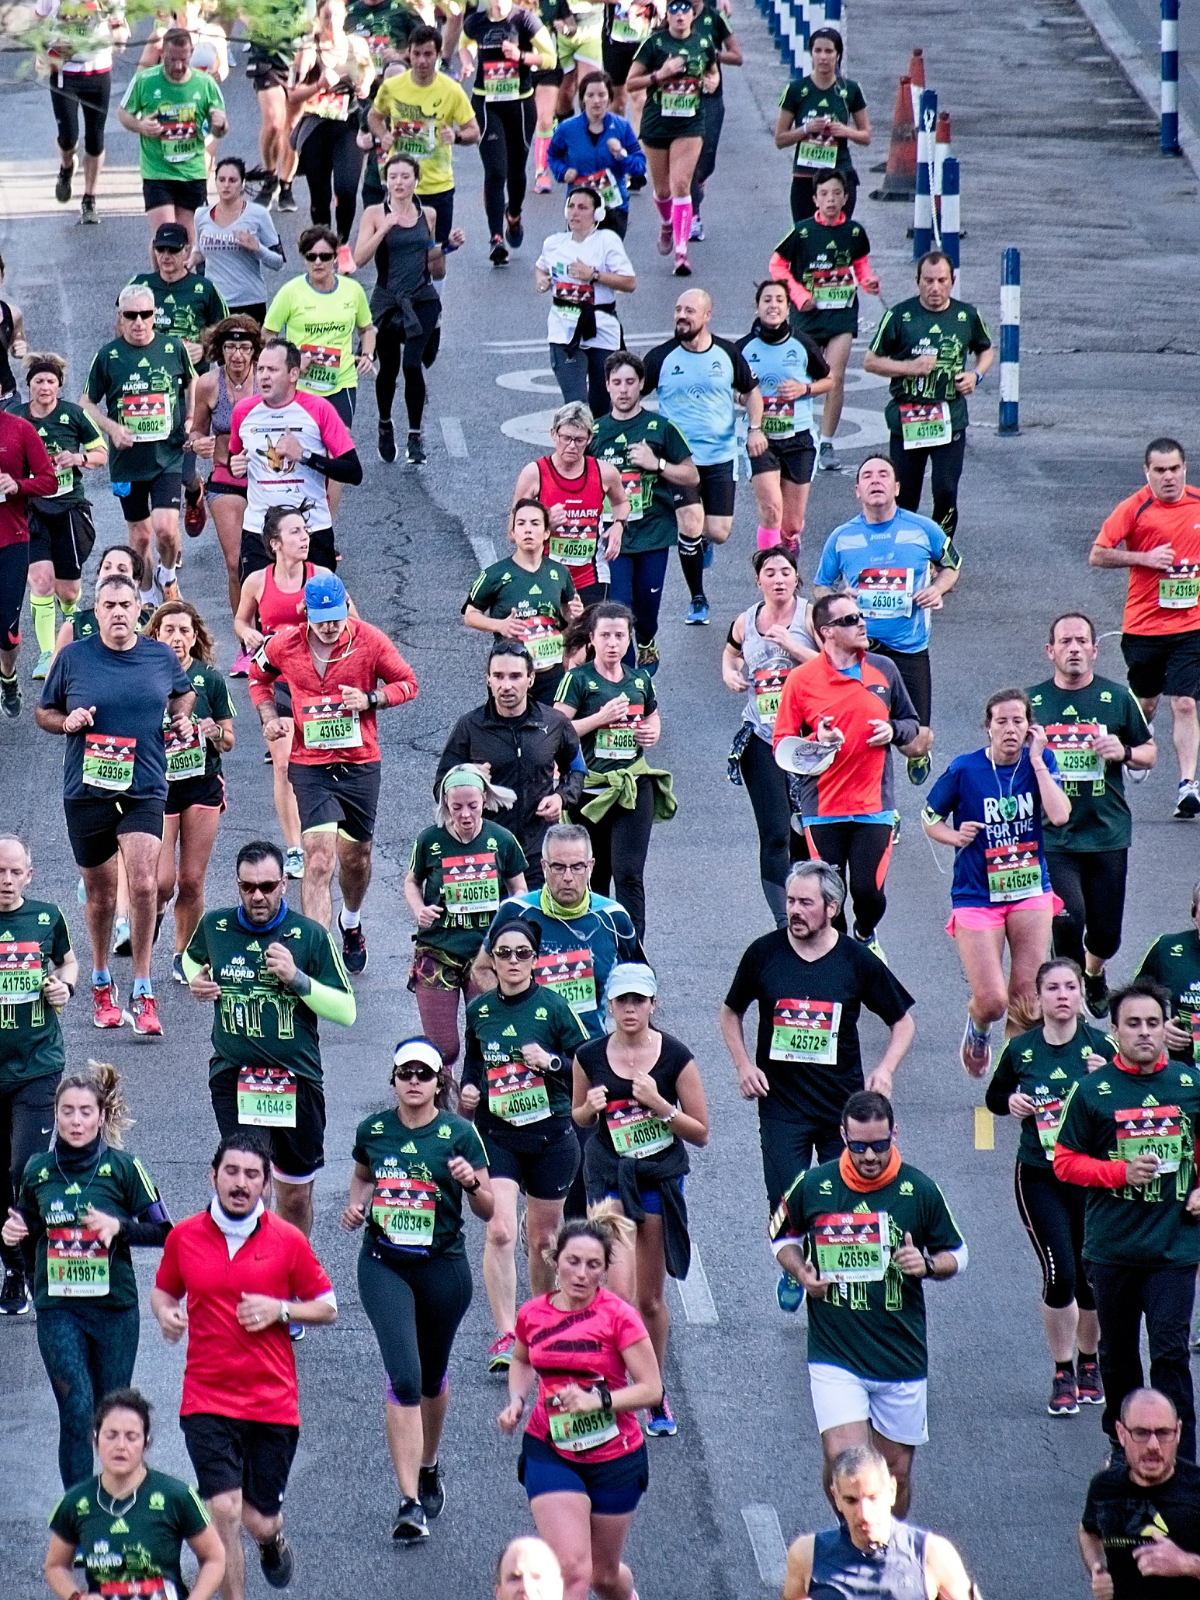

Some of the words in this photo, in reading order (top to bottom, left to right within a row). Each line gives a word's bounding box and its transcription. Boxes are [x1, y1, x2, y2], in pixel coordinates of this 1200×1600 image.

[122, 382, 149, 391] MADRID
[137, 421, 159, 432] 40802
[565, 509, 598, 518] NMARK
[872, 595, 897, 607] 26301
[319, 724, 345, 739] 43163
[1063, 755, 1090, 768] 42954
[97, 765, 123, 779] 42936
[986, 822, 1011, 839] FOR
[1013, 818, 1034, 834] THE
[1000, 874, 1032, 890] F41624
[456, 886, 489, 901] F40676
[232, 956, 245, 966] edp
[220, 968, 255, 979] MADRID
[2, 977, 31, 991] 41756
[235, 1005, 244, 1028] 2017
[790, 1036, 819, 1050] 42572
[482, 1052, 510, 1063] MADRID
[256, 1100, 284, 1114] 41644
[501, 1094, 538, 1116] F40694
[625, 1124, 661, 1148] F40897
[375, 1170, 408, 1180] MADRID
[384, 1214, 422, 1232] F40834
[837, 1252, 870, 1268] 42659
[58, 1266, 97, 1283] F41987
[564, 1416, 604, 1438] F40951
